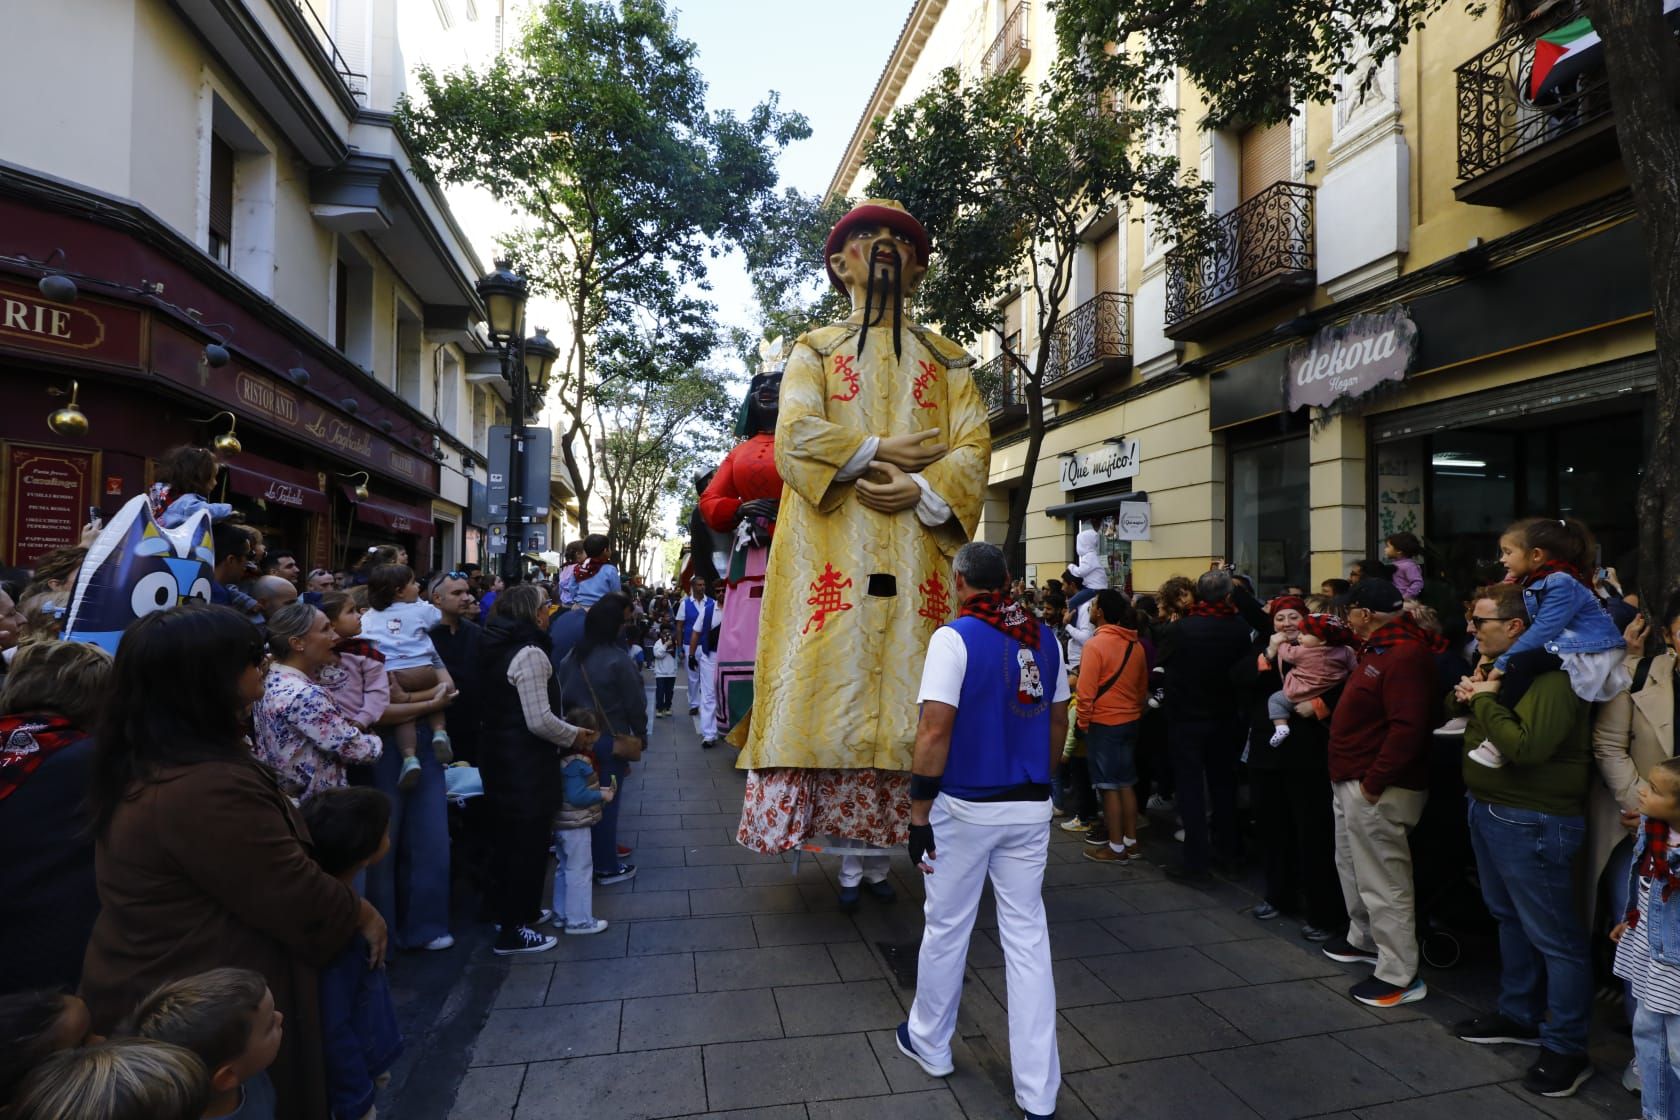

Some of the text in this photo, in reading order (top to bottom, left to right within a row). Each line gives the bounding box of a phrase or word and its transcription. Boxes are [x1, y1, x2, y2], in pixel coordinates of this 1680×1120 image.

[2, 299, 71, 338] RIE
[1297, 330, 1396, 386] dekora
[244, 379, 293, 420] RISTORANTI
[1329, 377, 1359, 392] Hogar
[304, 412, 372, 457] La Tagliatella
[1062, 442, 1136, 486] ¡Qué majico!
